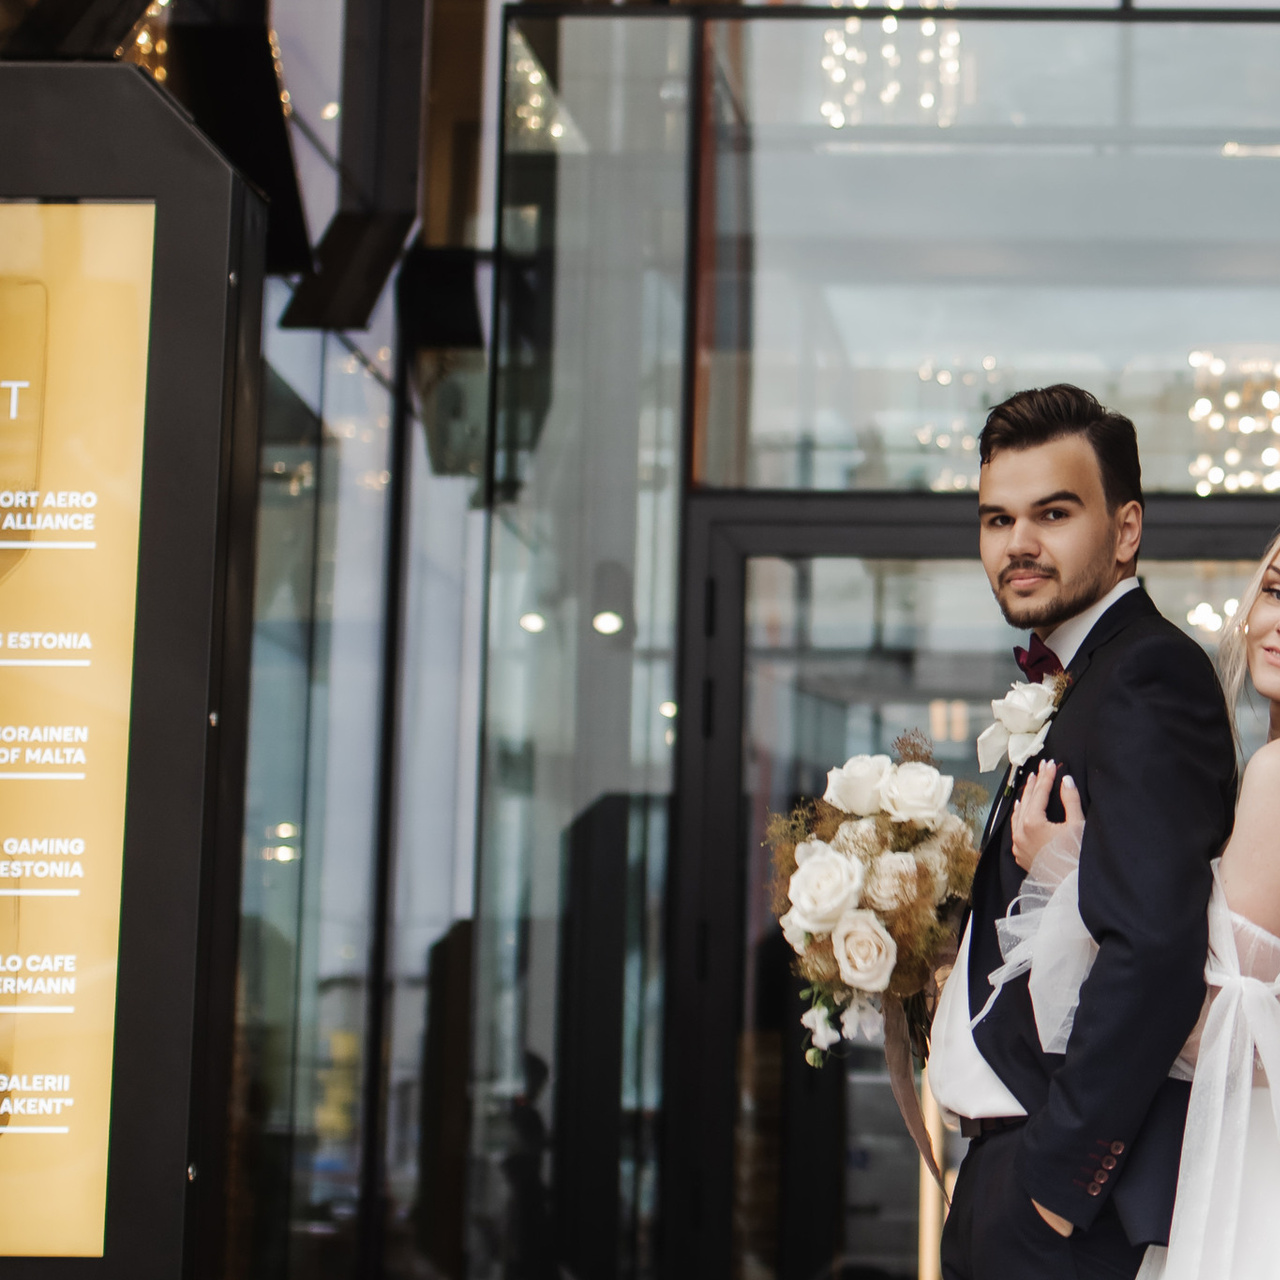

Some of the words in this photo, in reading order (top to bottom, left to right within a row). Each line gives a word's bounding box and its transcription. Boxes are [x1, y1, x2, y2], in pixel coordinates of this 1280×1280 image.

[42, 490, 98, 509] AERO
[2, 512, 96, 531] ALLIANCE
[7, 631, 93, 650] ESTONIA
[25, 746, 87, 765] MALTA
[3, 837, 86, 856] GAMING
[0, 860, 85, 879] ESTONIA
[25, 953, 77, 973] CAFE
